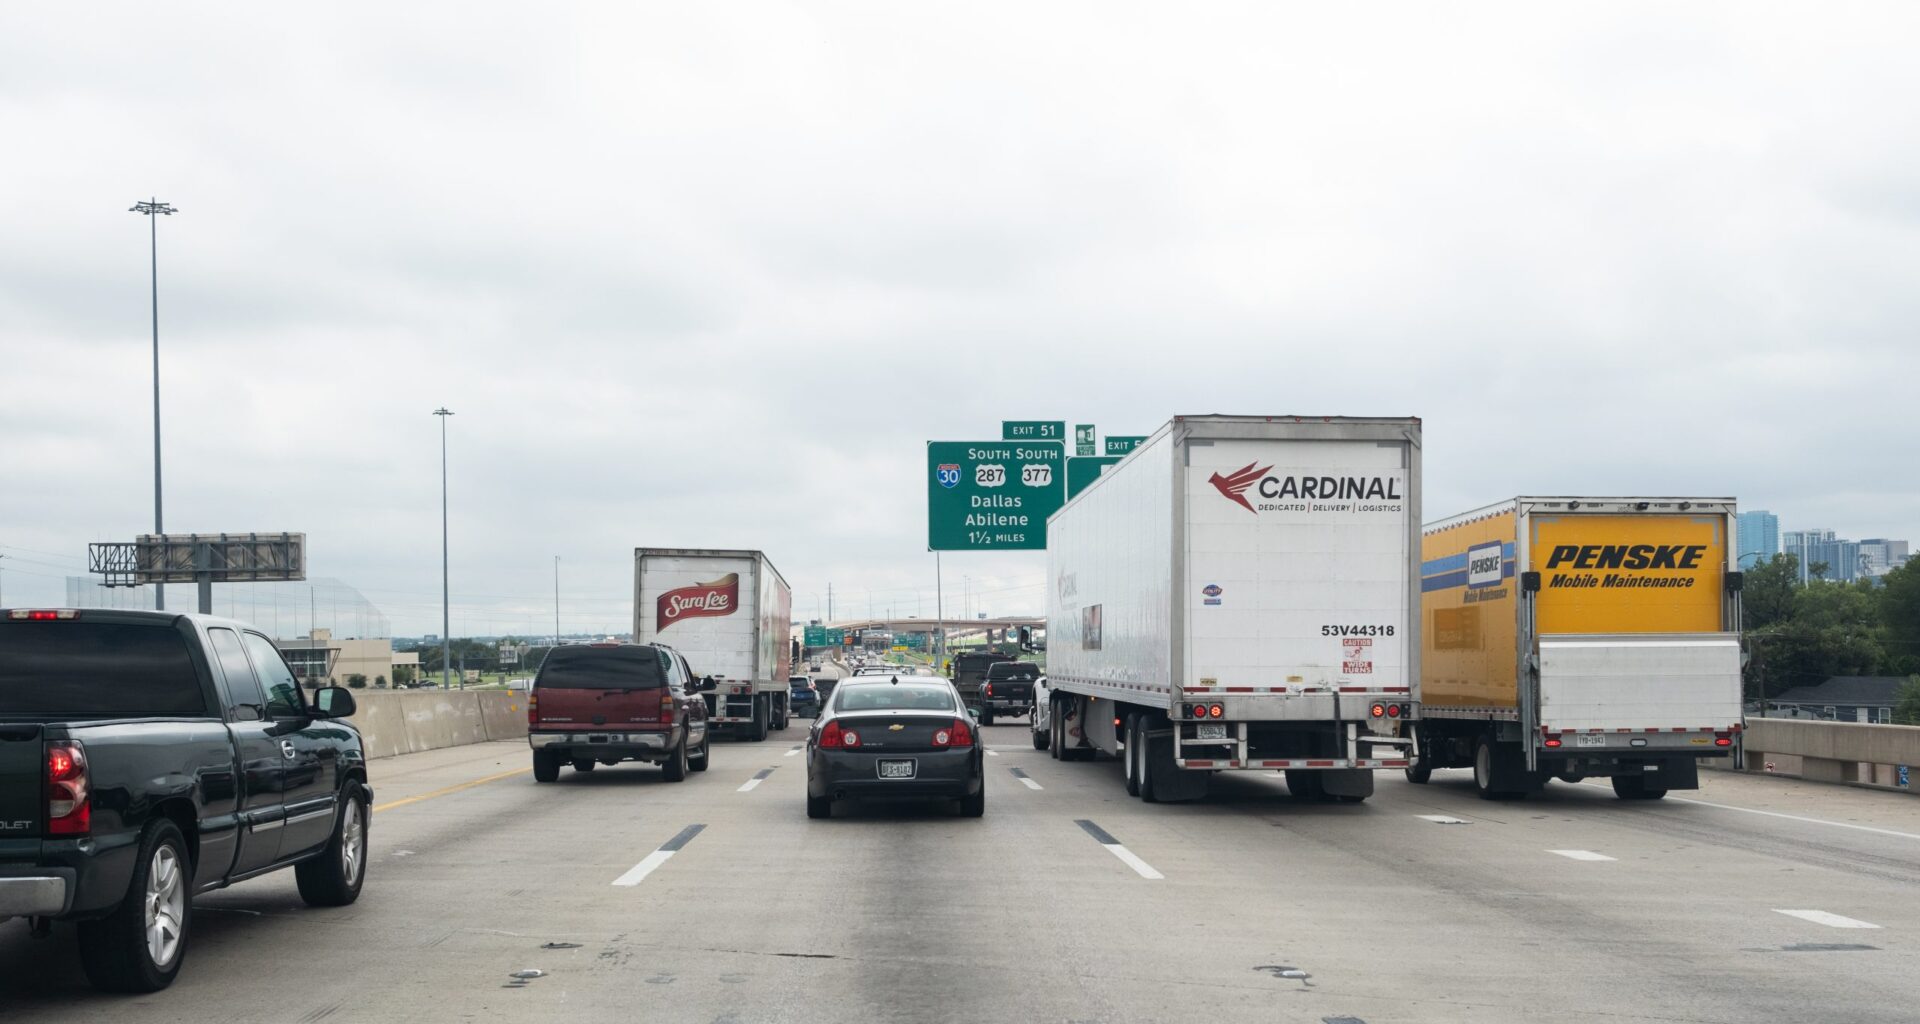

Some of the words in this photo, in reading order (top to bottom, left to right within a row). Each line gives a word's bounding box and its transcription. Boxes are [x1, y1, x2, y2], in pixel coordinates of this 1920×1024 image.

[1013, 426, 1034, 435] EXIT
[1041, 425, 1055, 436] 51
[1108, 441, 1129, 450] EXIT
[968, 448, 1010, 460] SOUTH
[1016, 448, 1058, 460] SOUTH
[940, 470, 959, 483] 30
[977, 468, 1004, 482] 287
[1023, 468, 1050, 482] 377
[1259, 476, 1401, 500] CARDINAL
[971, 494, 1022, 508] Dallas
[1258, 504, 1306, 512] DEDICATED
[1312, 504, 1351, 512] DELIVERY
[965, 512, 1028, 526] Abilene
[995, 534, 1025, 542] MILES
[1546, 545, 1707, 569] PENSKE
[1470, 556, 1500, 575] PENSKE
[1550, 574, 1598, 588] Mobile
[1601, 574, 1694, 588] Maintenance
[1321, 625, 1395, 636] 53V44318
